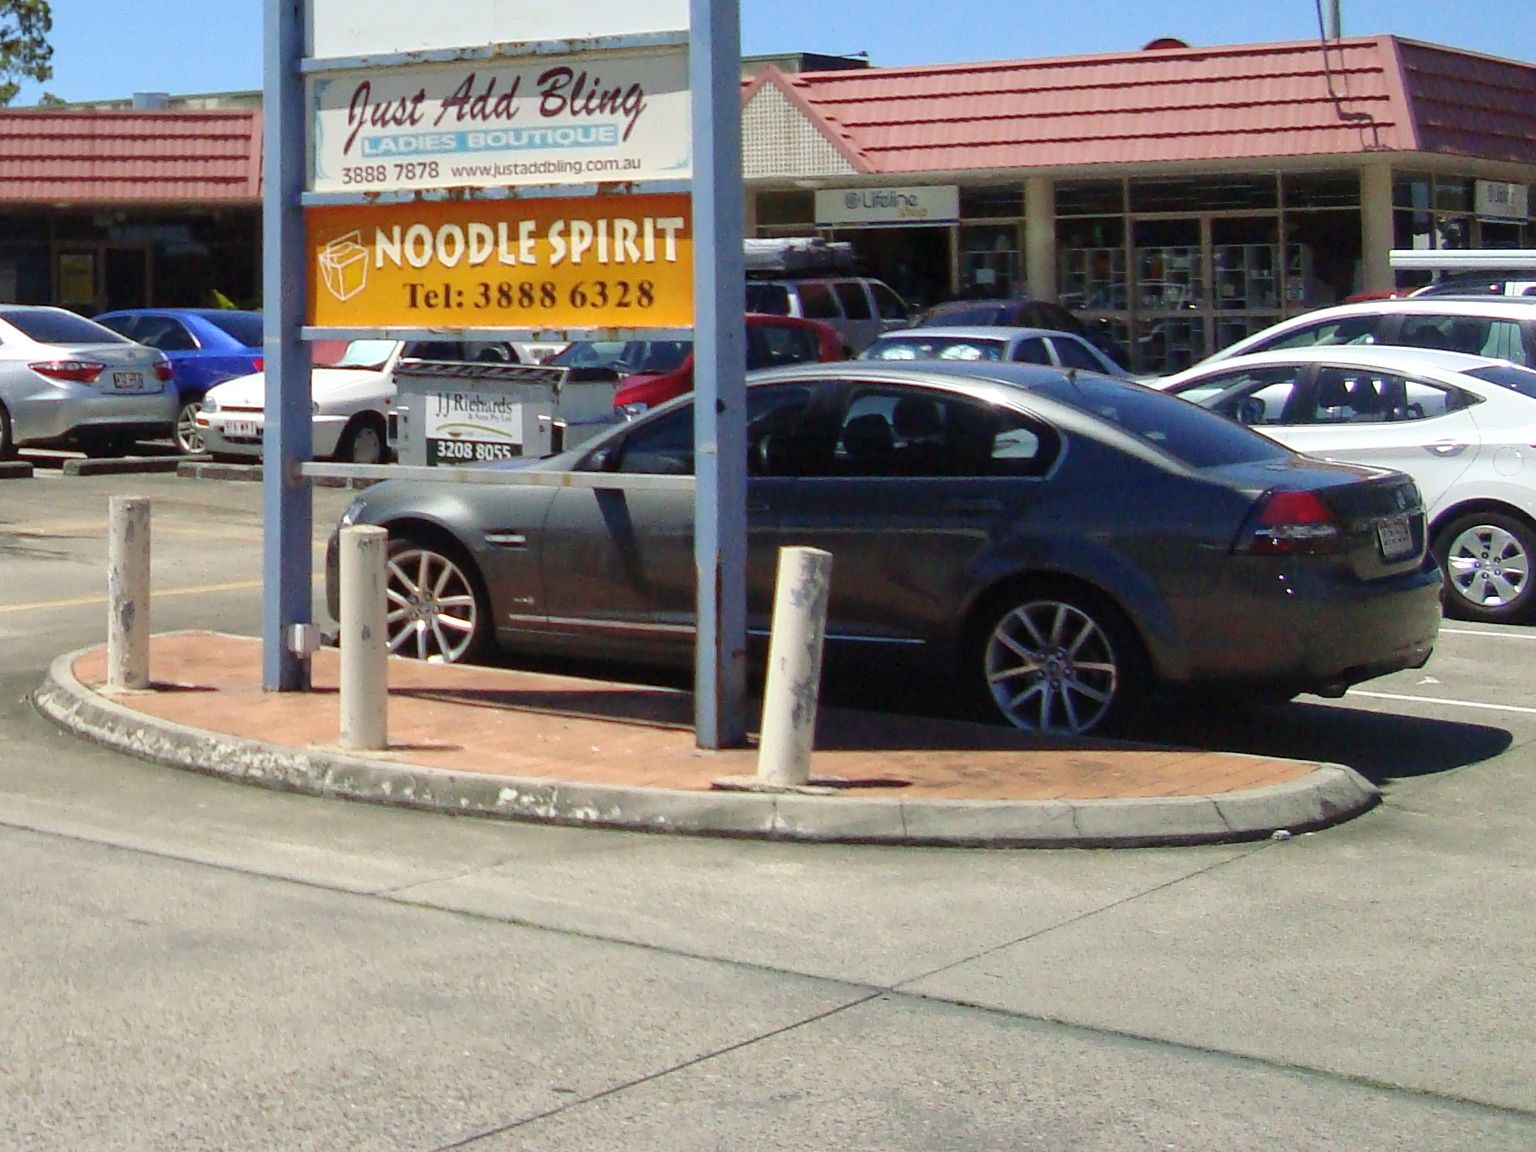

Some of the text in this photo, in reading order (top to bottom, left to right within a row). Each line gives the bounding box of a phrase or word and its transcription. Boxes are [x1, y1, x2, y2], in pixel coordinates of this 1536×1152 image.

[344, 66, 648, 156] Just Add Bling
[364, 125, 615, 155] LADIES BOUTIQUE
[342, 157, 641, 184] 3888 7878 www.justaddbling.com.au
[374, 216, 685, 268] NOODLE SPIRIT
[403, 280, 656, 309] Tel: 3888 6328
[454, 393, 512, 414] Richards
[437, 440, 512, 460] 3208 8055
